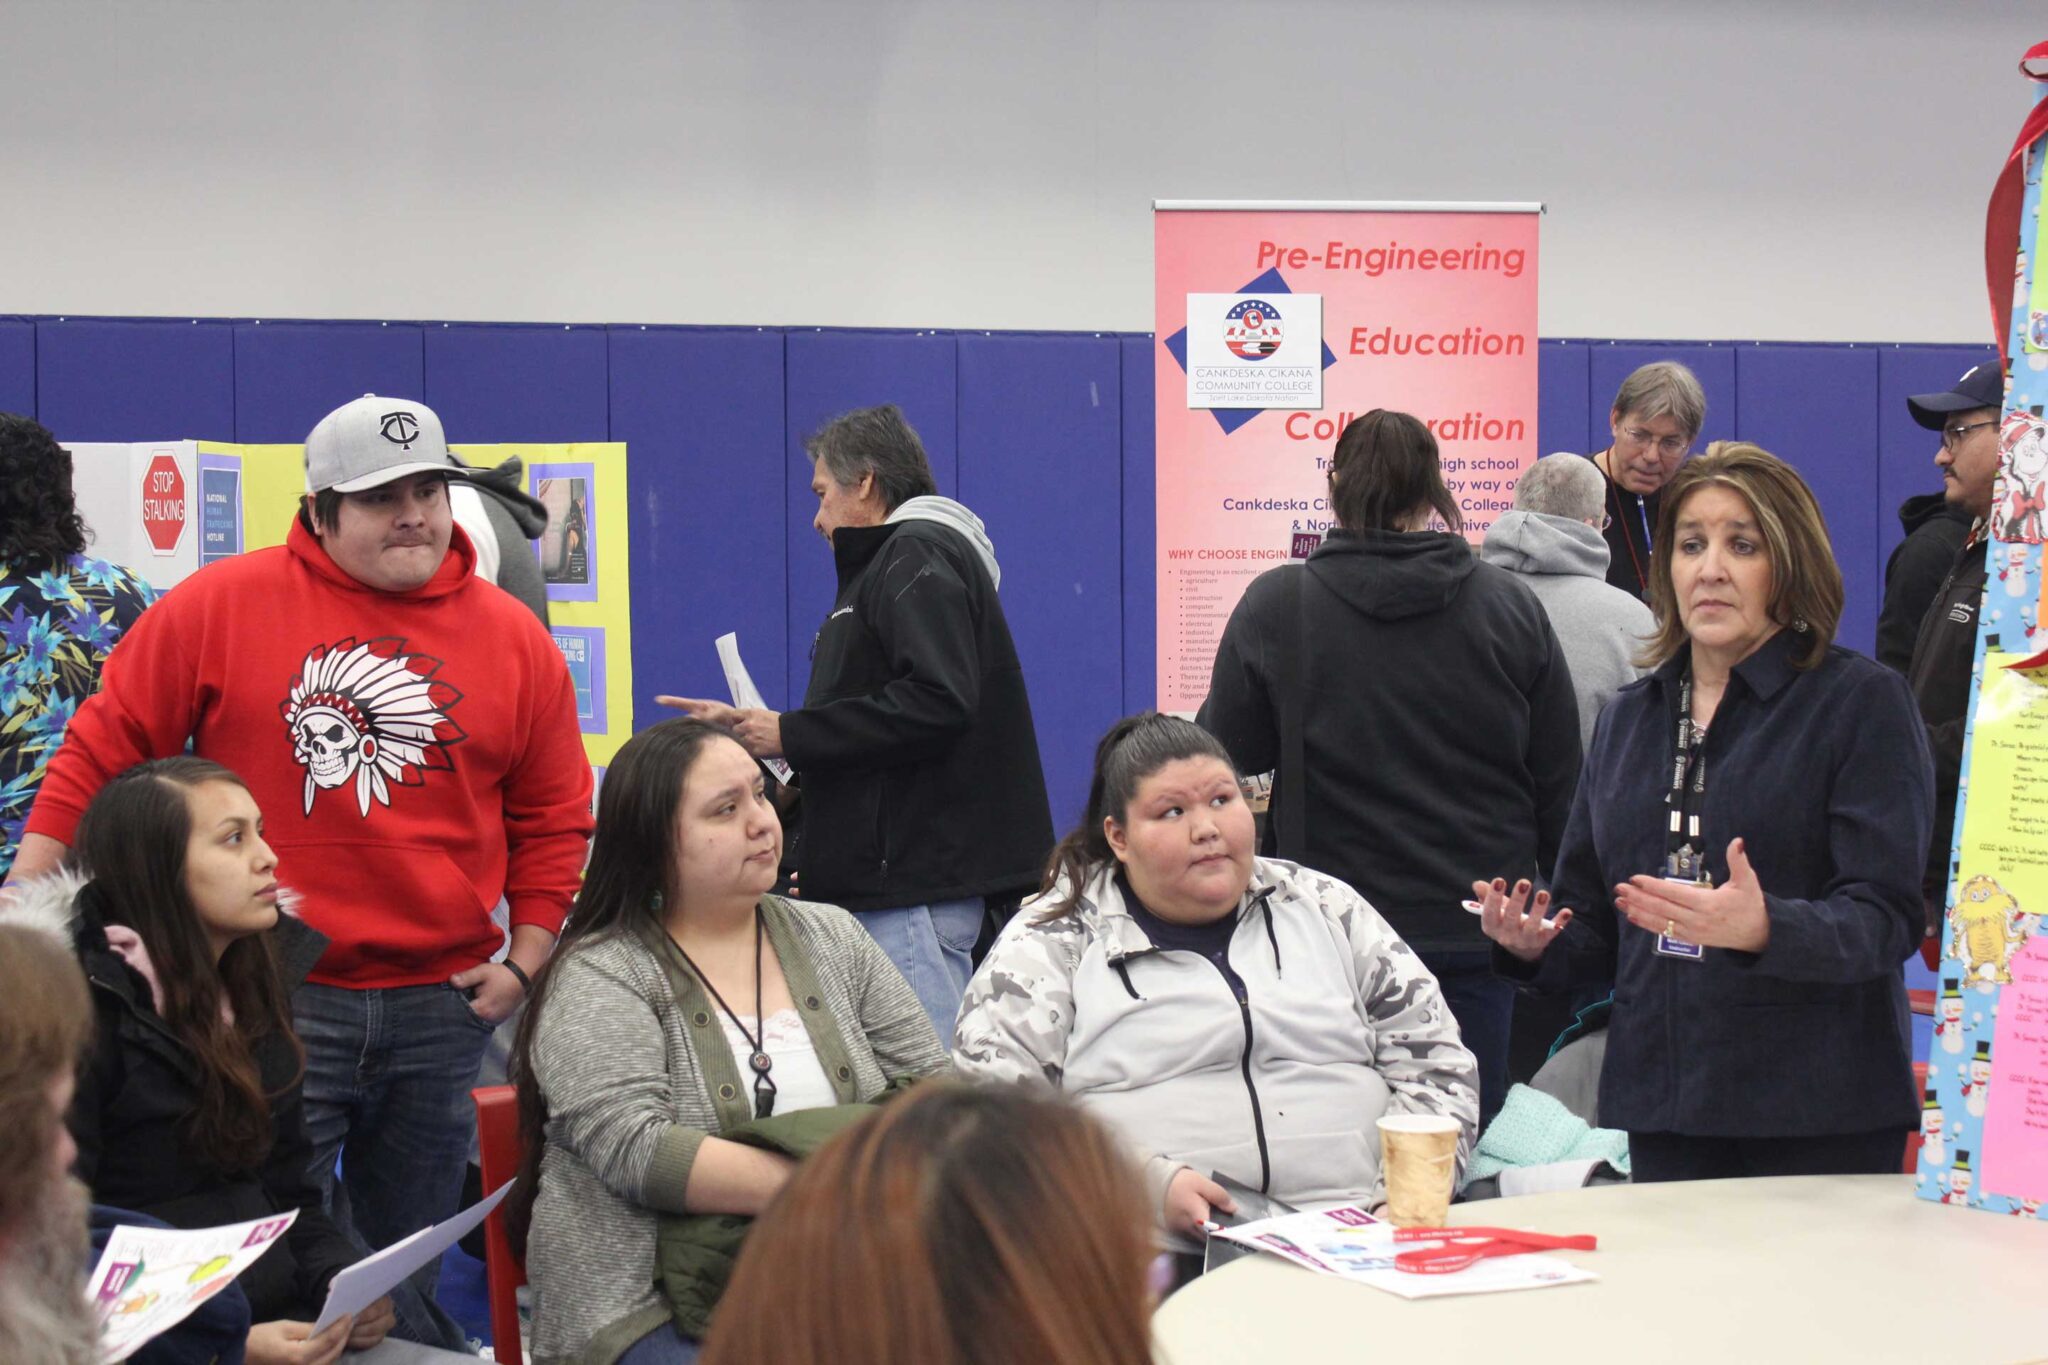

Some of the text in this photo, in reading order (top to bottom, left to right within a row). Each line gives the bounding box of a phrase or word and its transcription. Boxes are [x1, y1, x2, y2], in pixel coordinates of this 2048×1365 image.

[1256, 241, 1525, 278] Pre-Engineering
[1349, 326, 1525, 356] Education
[1195, 368, 1313, 378] CANKDESKA CIKANA
[1195, 381, 1313, 391] COMMUNITY COLLEGE
[1471, 457, 1518, 470] school
[153, 471, 175, 493] STOP
[1447, 478, 1465, 493] by
[1470, 481, 1501, 493] way
[206, 494, 228, 503] NATIONAL
[1223, 498, 1308, 511] Cankdeska
[1461, 498, 1514, 512] Colleg
[144, 499, 184, 521] STALKING
[1292, 519, 1301, 530] &
[206, 533, 225, 541] HOTLINE
[1168, 549, 1288, 560] WHY CHOOSE ENGIN
